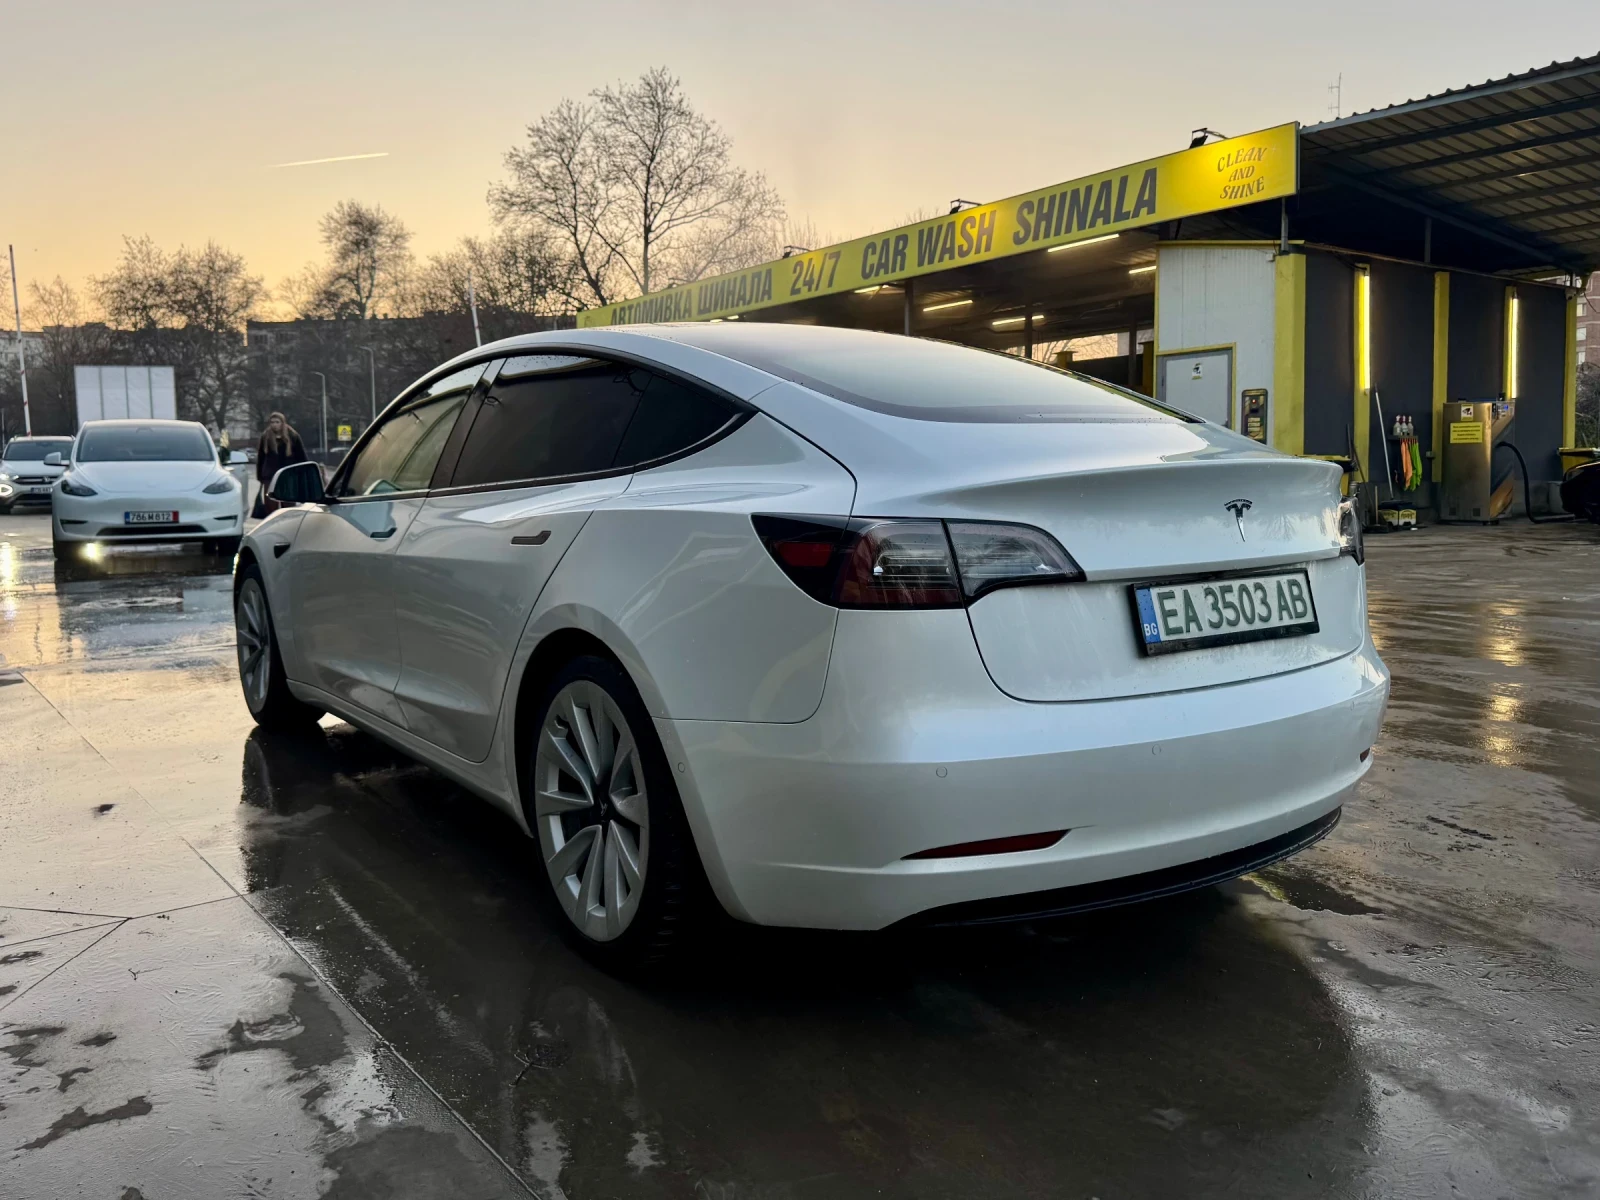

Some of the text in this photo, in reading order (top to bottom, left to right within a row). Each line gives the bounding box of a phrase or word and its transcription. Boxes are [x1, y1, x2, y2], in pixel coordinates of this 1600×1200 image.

[1217, 147, 1267, 172] CLEAN
[1228, 166, 1255, 182] AND
[1220, 176, 1265, 200] SHINE
[861, 168, 1157, 280] CAR WASH SHINALA
[790, 251, 842, 296] 24/7
[611, 268, 772, 325] АВТОМИВКА ШИНАЛА
[1157, 579, 1308, 636] EA 3503 AB
[1144, 623, 1158, 637] BG
